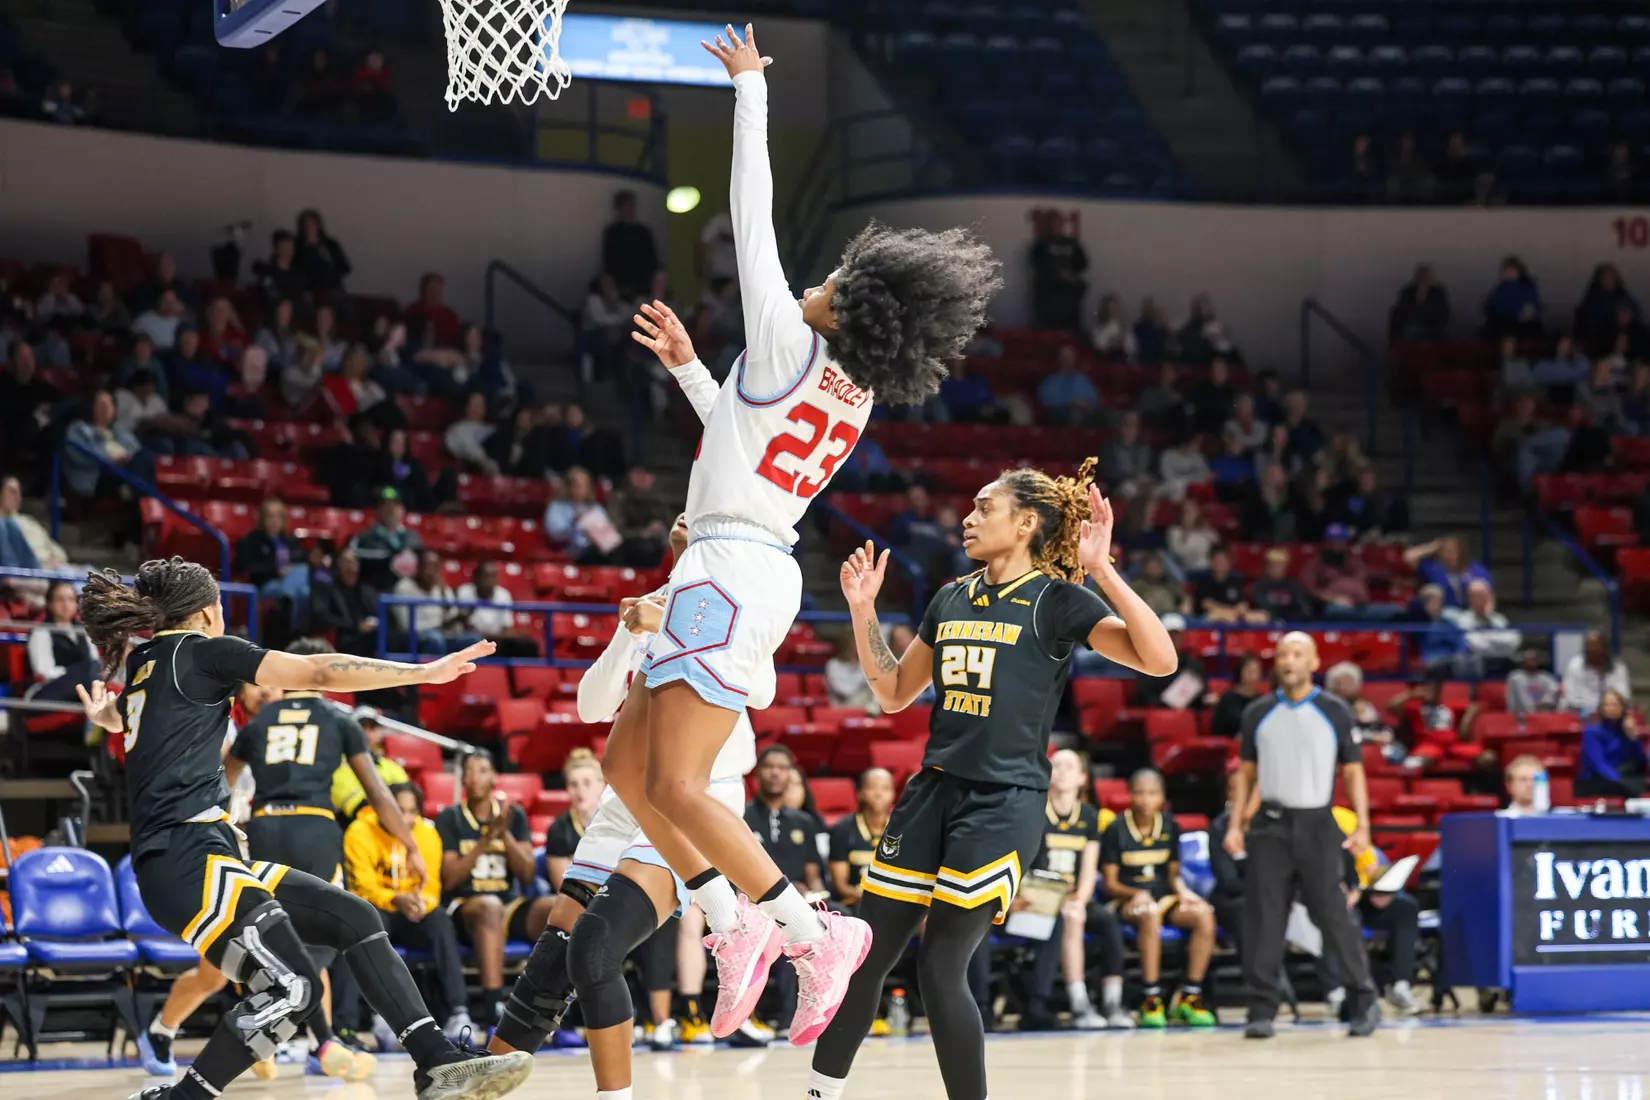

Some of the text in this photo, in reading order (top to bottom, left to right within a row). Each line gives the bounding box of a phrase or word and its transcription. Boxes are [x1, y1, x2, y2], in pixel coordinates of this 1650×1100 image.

[755, 400, 859, 499] 23
[941, 645, 996, 689] 24
[124, 689, 147, 753] 3
[943, 690, 992, 717] STATE
[265, 724, 320, 765] 21
[1540, 908, 1650, 940] FUR
